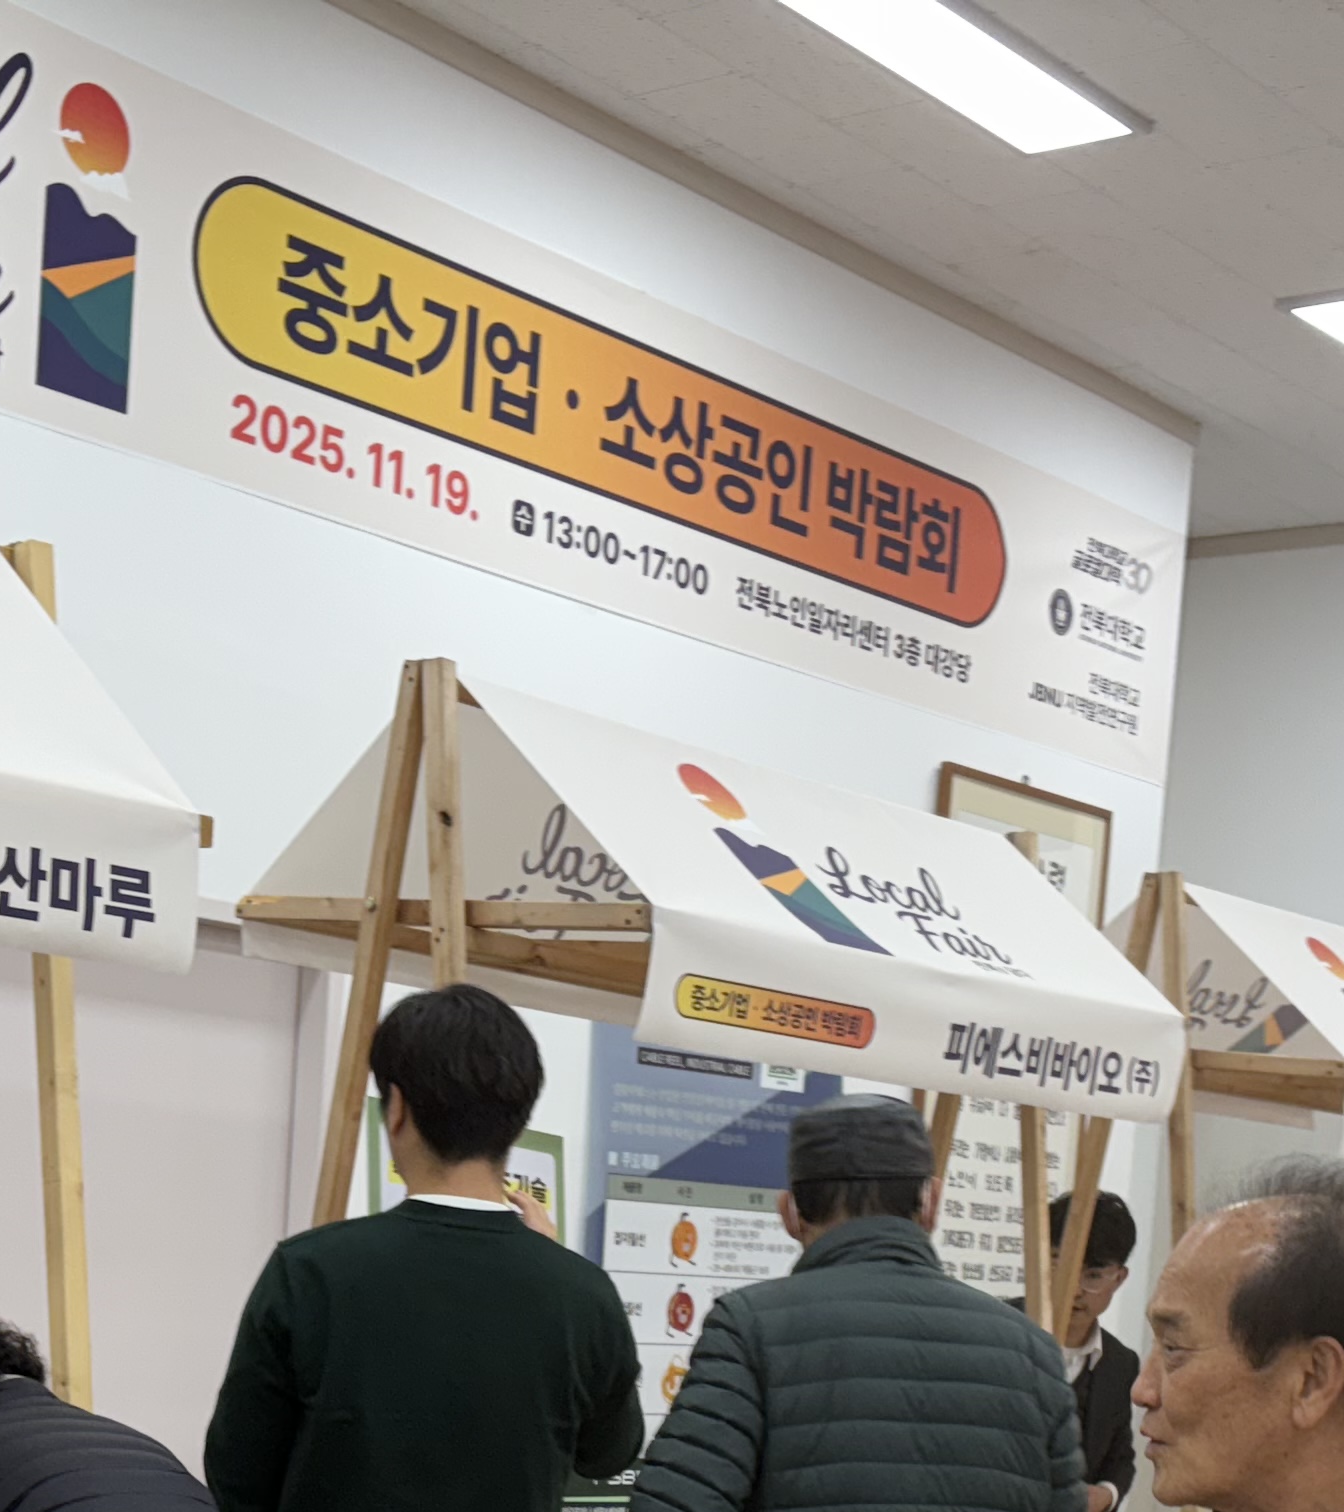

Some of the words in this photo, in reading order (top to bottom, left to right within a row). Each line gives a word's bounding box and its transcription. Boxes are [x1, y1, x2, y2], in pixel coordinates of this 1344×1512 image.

[278, 234, 541, 434] 중소기업
[599, 376, 814, 537] 소상공인
[827, 460, 962, 593] 박람회
[230, 393, 355, 480] 2025.
[367, 442, 414, 500] 11.
[425, 463, 479, 522] 19.
[513, 500, 535, 537] 수
[542, 511, 710, 596] 13:00~17:00
[735, 576, 890, 659] 전북노인일자리센터
[893, 633, 922, 668] 3층
[925, 642, 973, 684] 대강당
[815, 845, 962, 920] Local
[896, 910, 1013, 965] Fair
[691, 983, 751, 1020] 중소기업
[762, 998, 819, 1033] 소상공인
[821, 1009, 864, 1040] 박람회
[943, 1021, 1122, 1096] 피에스비바이오
[1125, 1055, 1161, 1098] (주)
